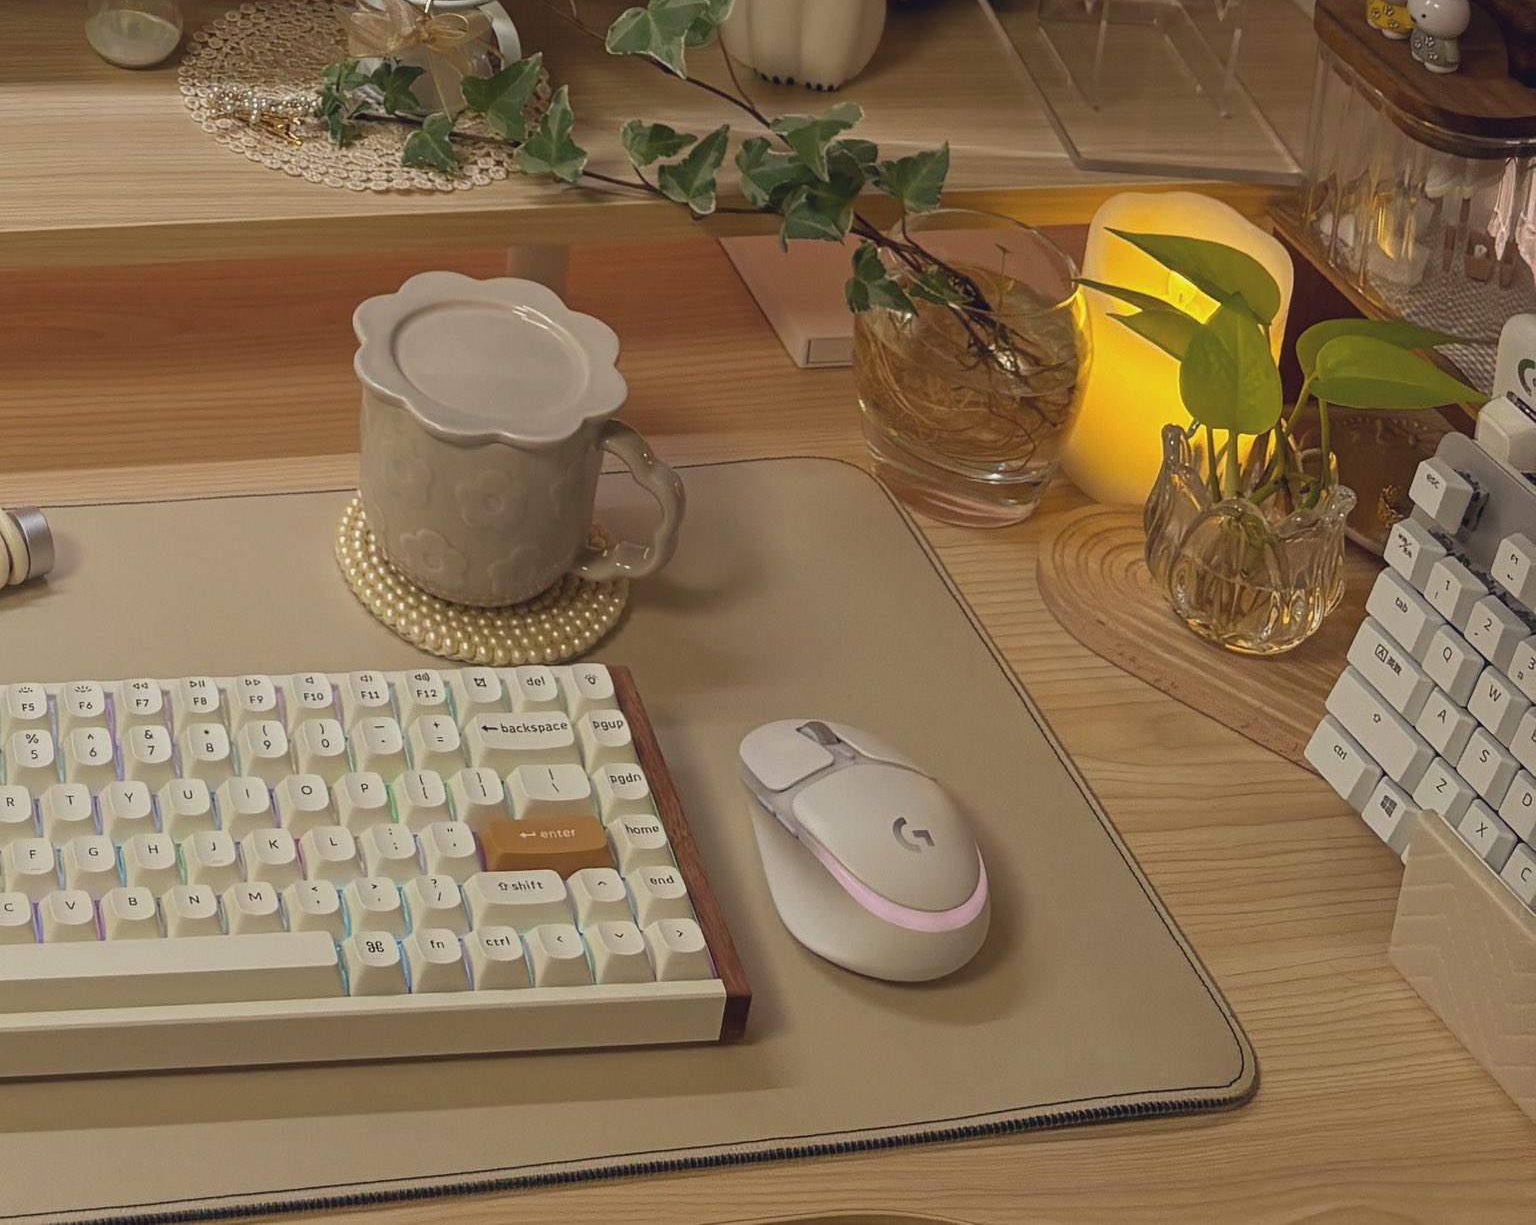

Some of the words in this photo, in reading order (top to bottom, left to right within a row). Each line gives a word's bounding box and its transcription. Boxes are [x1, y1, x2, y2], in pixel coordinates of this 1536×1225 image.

[1394, 597, 1408, 613] tab
[1483, 618, 1492, 631] 2
[1443, 646, 1453, 663] Q
[526, 676, 546, 687] del
[303, 692, 325, 702] F10
[360, 690, 380, 700] F11
[416, 689, 438, 698] F12
[1488, 684, 1502, 702] W
[78, 701, 93, 710] F6
[135, 698, 150, 708] F7
[192, 696, 208, 706] F8
[249, 695, 264, 705] F9
[21, 702, 35, 712] F5
[1437, 709, 1447, 724] A
[499, 722, 568, 734] backspace
[592, 718, 625, 732] pgup
[146, 745, 155, 756] 7
[262, 739, 272, 751] 9
[30, 749, 39, 760] 5
[89, 746, 98, 758] 6
[1333, 744, 1348, 760] ctrl
[1479, 749, 1490, 763] S
[609, 772, 642, 786] pgdn
[300, 785, 313, 796] O
[360, 783, 369, 793] P
[1435, 777, 1447, 793] Z
[124, 792, 134, 804] Y
[182, 789, 193, 800] U
[1521, 792, 1533, 807] D
[5, 796, 15, 807] R
[65, 795, 75, 806] T
[540, 827, 576, 840] enter
[624, 823, 659, 835] home
[1475, 822, 1488, 838] X
[268, 839, 280, 850] K
[329, 837, 338, 847] L
[29, 849, 37, 860] F
[88, 847, 99, 857] G
[147, 844, 159, 855] H
[1520, 867, 1532, 882] C
[511, 880, 544, 891] shift
[649, 875, 675, 886] end
[128, 896, 138, 906] B
[188, 895, 201, 905] N
[248, 891, 263, 902] M
[3, 902, 14, 912] C
[65, 901, 76, 911] V
[429, 939, 445, 949] fn
[485, 935, 511, 947] ctrl
